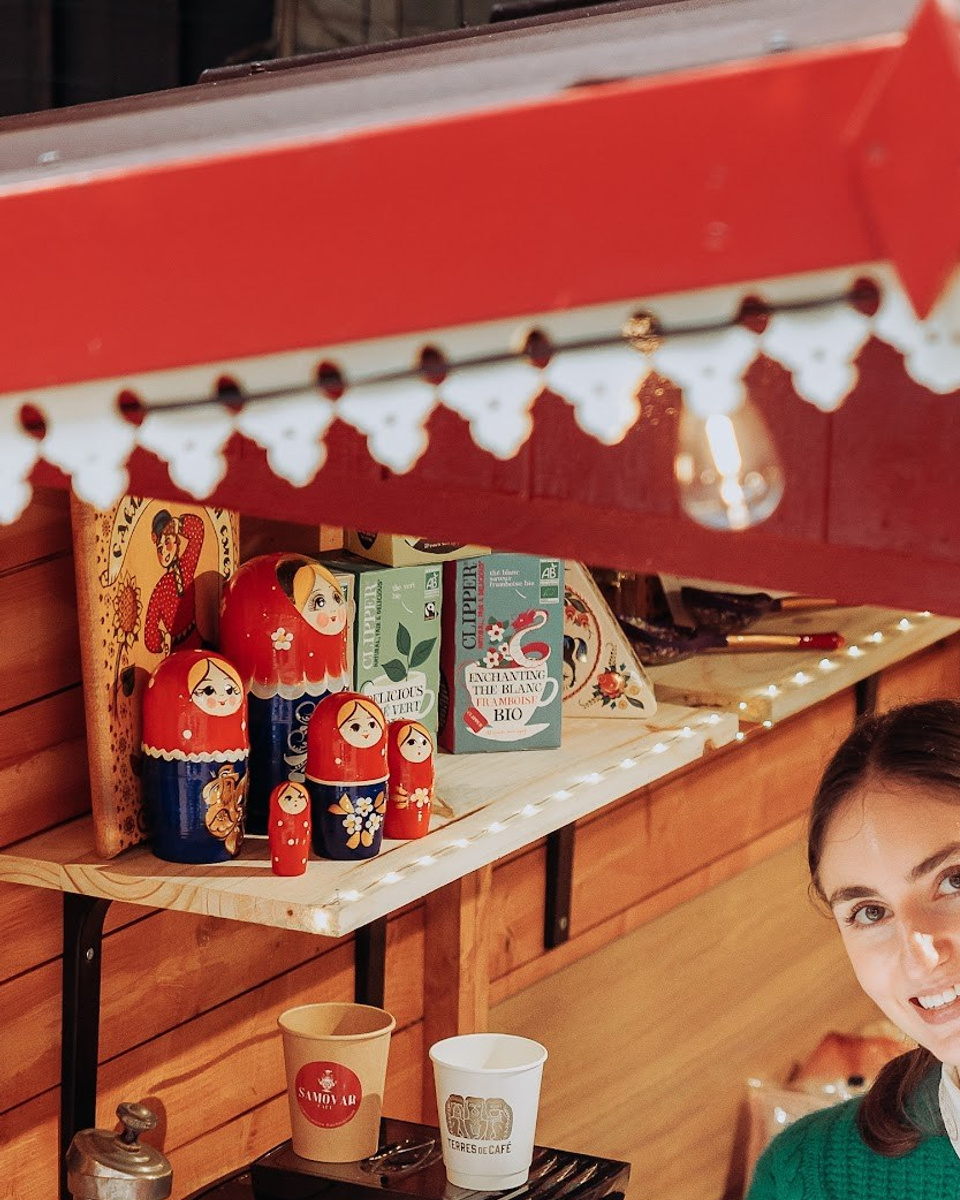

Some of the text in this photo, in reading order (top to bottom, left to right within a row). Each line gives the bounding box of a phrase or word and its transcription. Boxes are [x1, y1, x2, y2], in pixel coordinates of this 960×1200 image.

[541, 566, 557, 579] AB
[462, 563, 477, 650] CLIPPER
[362, 583, 377, 670] CLIPPER
[469, 670, 546, 683] ENCHANTING
[502, 683, 543, 695] BLANC
[394, 701, 422, 716] VERT
[476, 696, 536, 707] FRAMBOISE
[494, 707, 523, 722] BIO
[298, 1087, 357, 1106] SAMOVAR
[446, 1138, 477, 1154] TERRES
[488, 1141, 512, 1155] CAFÉ
